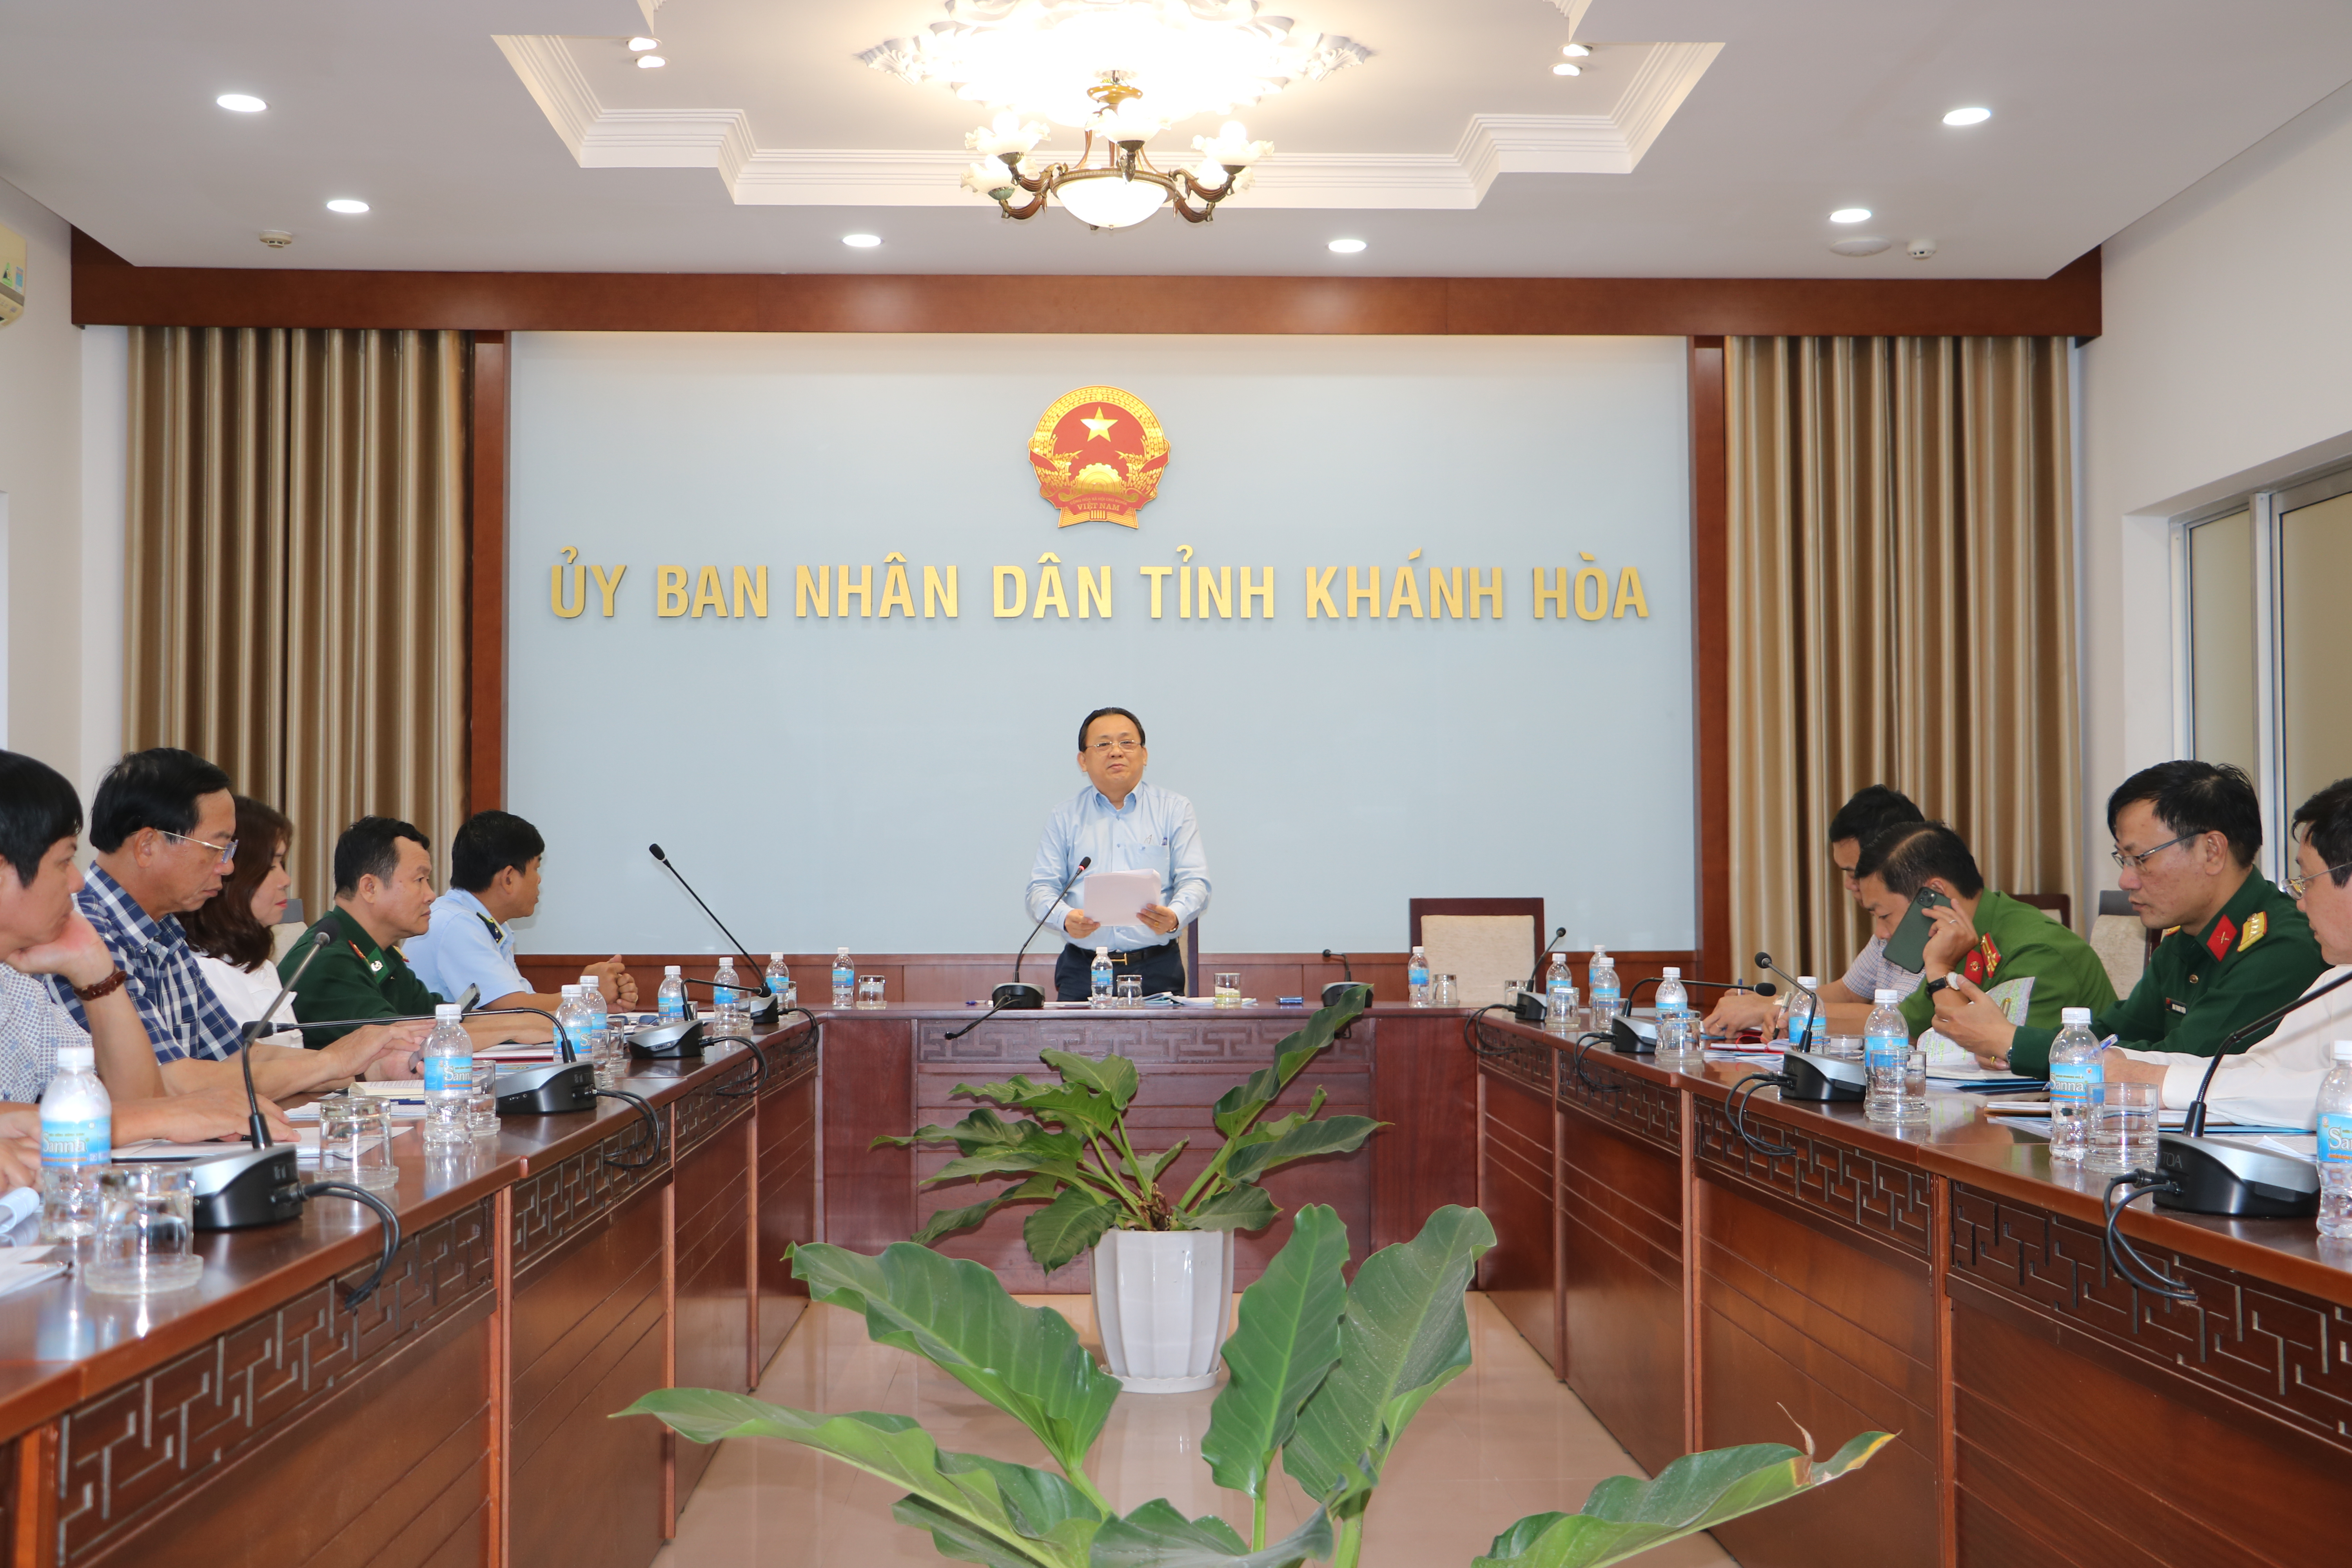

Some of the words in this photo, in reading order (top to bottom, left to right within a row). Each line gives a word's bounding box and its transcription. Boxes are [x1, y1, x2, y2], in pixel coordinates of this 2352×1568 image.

[1076, 501, 1098, 510] VIỆT
[1099, 503, 1120, 511] NAM
[551, 546, 627, 618] ỦY
[657, 565, 768, 618] BAN
[796, 552, 958, 618] NHÂN
[993, 552, 1112, 618] DÂN
[1140, 544, 1274, 619] TỈNH
[1306, 548, 1503, 619] KHÁNH
[1533, 552, 1649, 621] HÒA
[2050, 1073, 2085, 1092] Sanna
[42, 1132, 87, 1153] Sanna
[2163, 1152, 2182, 1169] TOA
